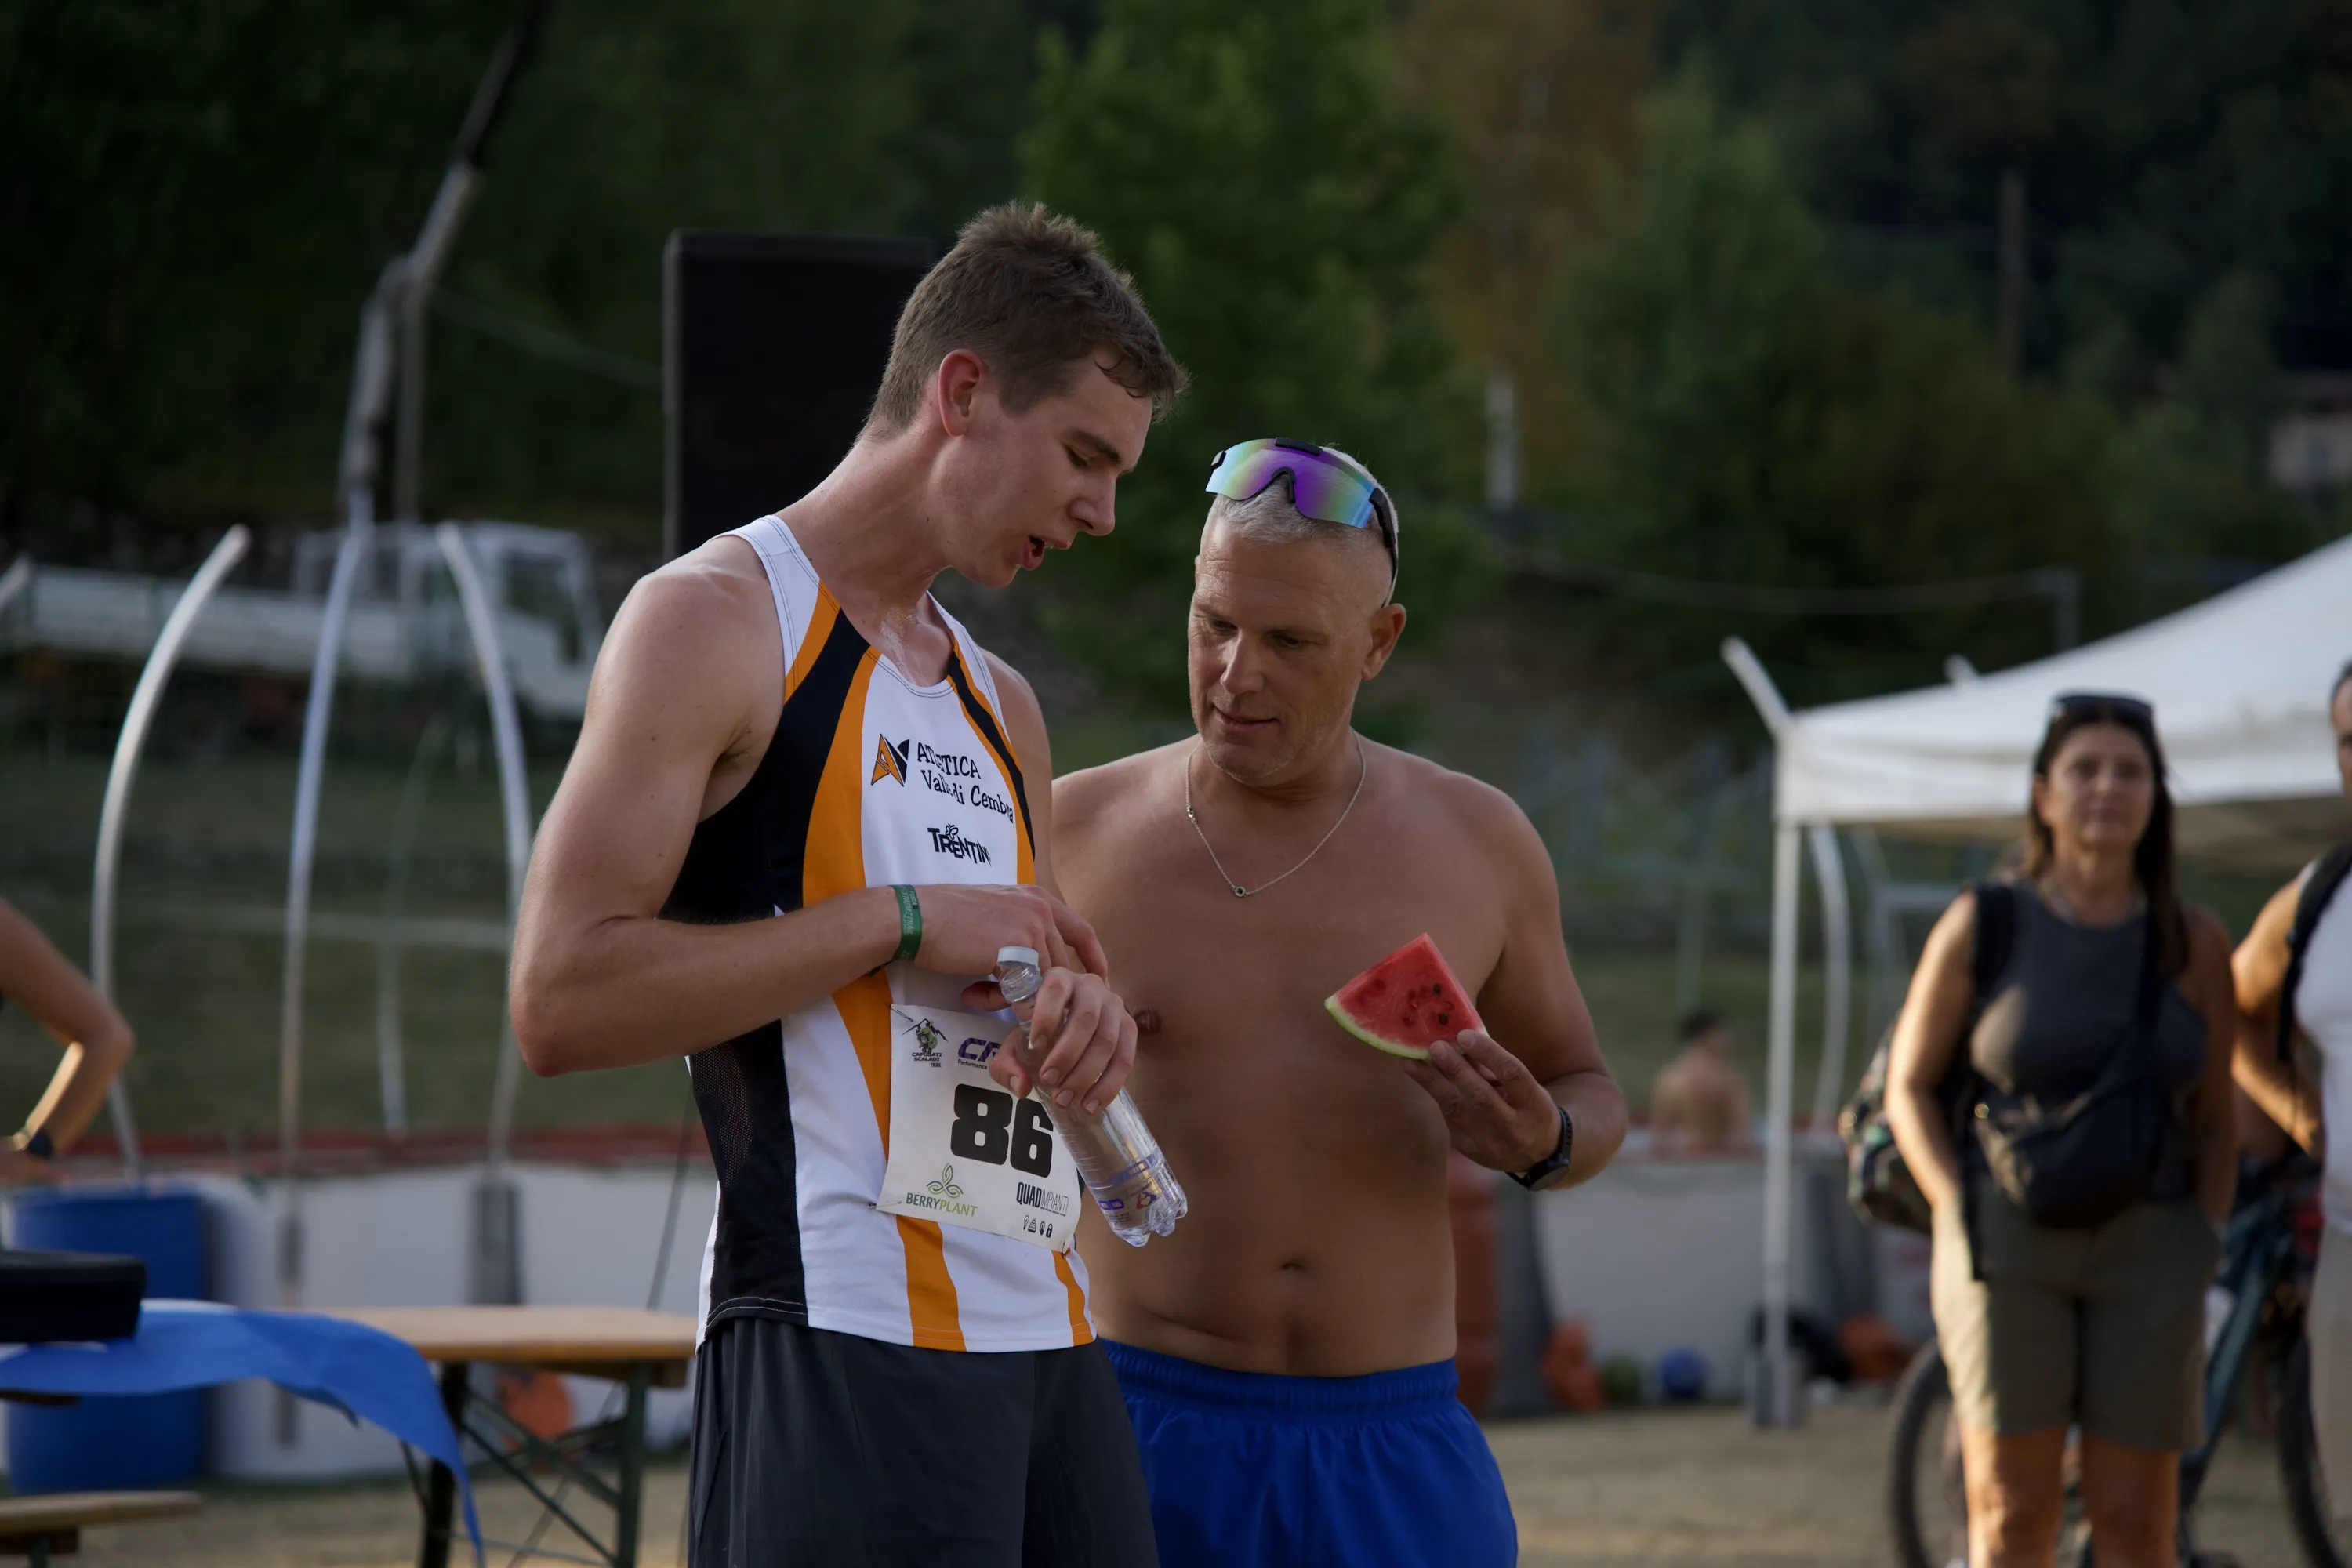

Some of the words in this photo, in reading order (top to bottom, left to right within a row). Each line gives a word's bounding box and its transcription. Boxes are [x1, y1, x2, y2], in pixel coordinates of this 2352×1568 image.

[953, 783, 965, 805] di
[957, 1058, 988, 1070] Performance
[950, 1083, 1054, 1178] 86
[906, 1192, 978, 1218] BERRYPLANT
